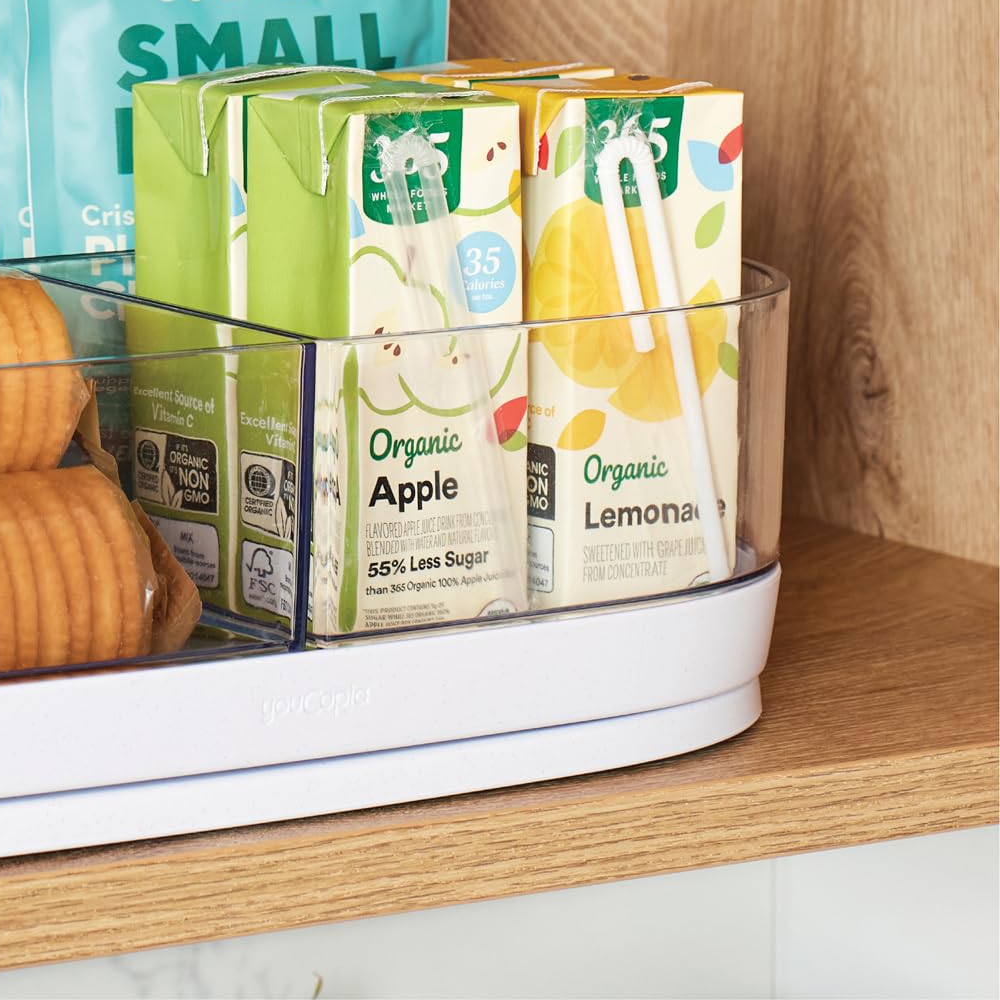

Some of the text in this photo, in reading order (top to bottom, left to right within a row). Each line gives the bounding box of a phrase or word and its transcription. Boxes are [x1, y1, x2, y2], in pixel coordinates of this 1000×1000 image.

[116, 12, 397, 92] SMALL
[81, 204, 134, 226] Cris
[464, 247, 501, 276] 35
[464, 279, 505, 291] alories
[175, 390, 203, 411] Source
[205, 398, 216, 414] of
[544, 406, 556, 417] of
[152, 402, 194, 428] Vitamin C
[370, 427, 462, 469] Organic
[170, 450, 209, 472] ORGANIC
[178, 468, 210, 492] NON
[584, 454, 668, 492] Organic
[184, 488, 210, 505] GMO
[368, 471, 458, 512] Apple
[528, 475, 548, 496] ON
[244, 505, 272, 516] ORGANIC
[245, 497, 273, 507] CERTIFIED
[180, 531, 193, 544] MIX
[365, 522, 402, 539] FLAVORED
[404, 520, 420, 537] APPLE
[366, 540, 400, 557] BLENDED
[584, 542, 630, 563] SWEETENED
[633, 540, 653, 561] WITH
[656, 538, 683, 559] GRAPE
[367, 550, 488, 577] 55% Less Sugar
[583, 561, 668, 584] FROM CONCENTRATE
[249, 578, 276, 595] FSC
[366, 574, 482, 595] than 365 Organic 100% Apple
[262, 684, 370, 726] youCopia
